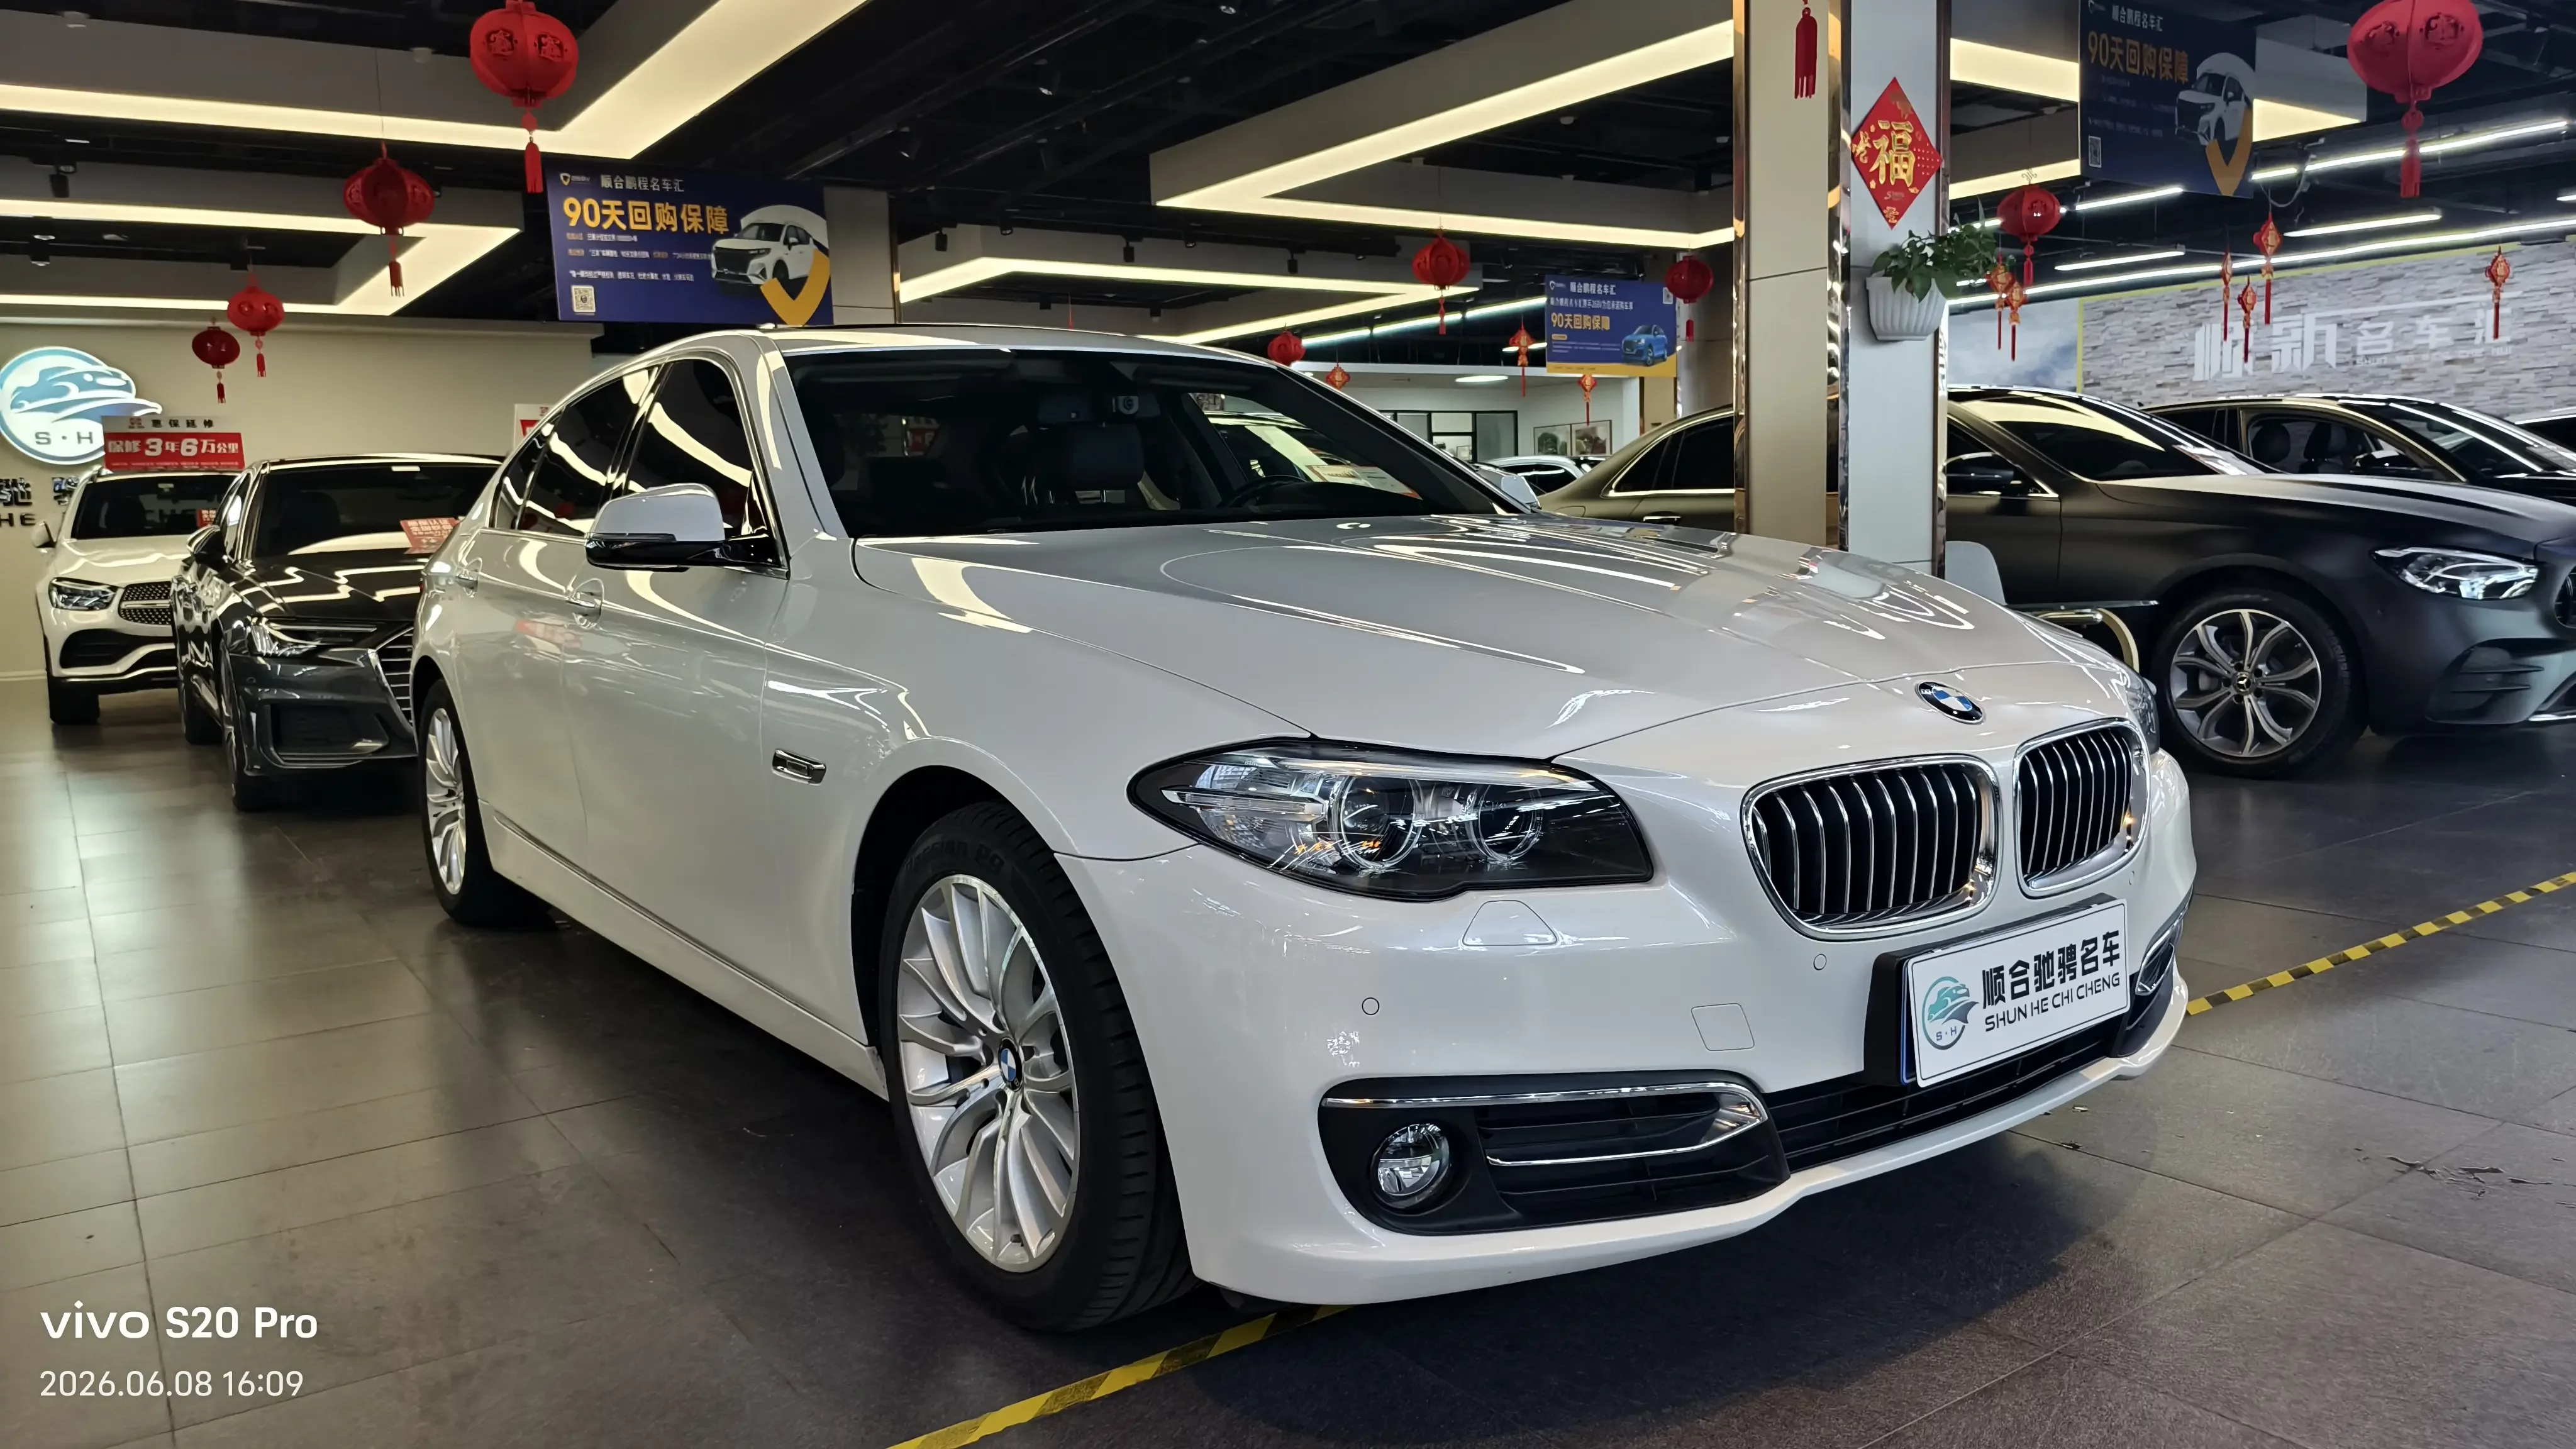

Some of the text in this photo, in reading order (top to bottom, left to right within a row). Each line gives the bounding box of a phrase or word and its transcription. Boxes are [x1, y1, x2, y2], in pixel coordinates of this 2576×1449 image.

[2088, 30, 2189, 84] 90天回购保障
[1869, 119, 1916, 187] 福
[601, 174, 685, 192] 顺合鹏程名车汇
[563, 196, 730, 235] 90天回购保障
[1551, 312, 1611, 331] 90天回购保障
[108, 438, 239, 457] 保修3年6万公里
[1982, 930, 2120, 1009] 顺合驰骋名车
[1985, 972, 2120, 1032] SHUN HE CHI CHENG
